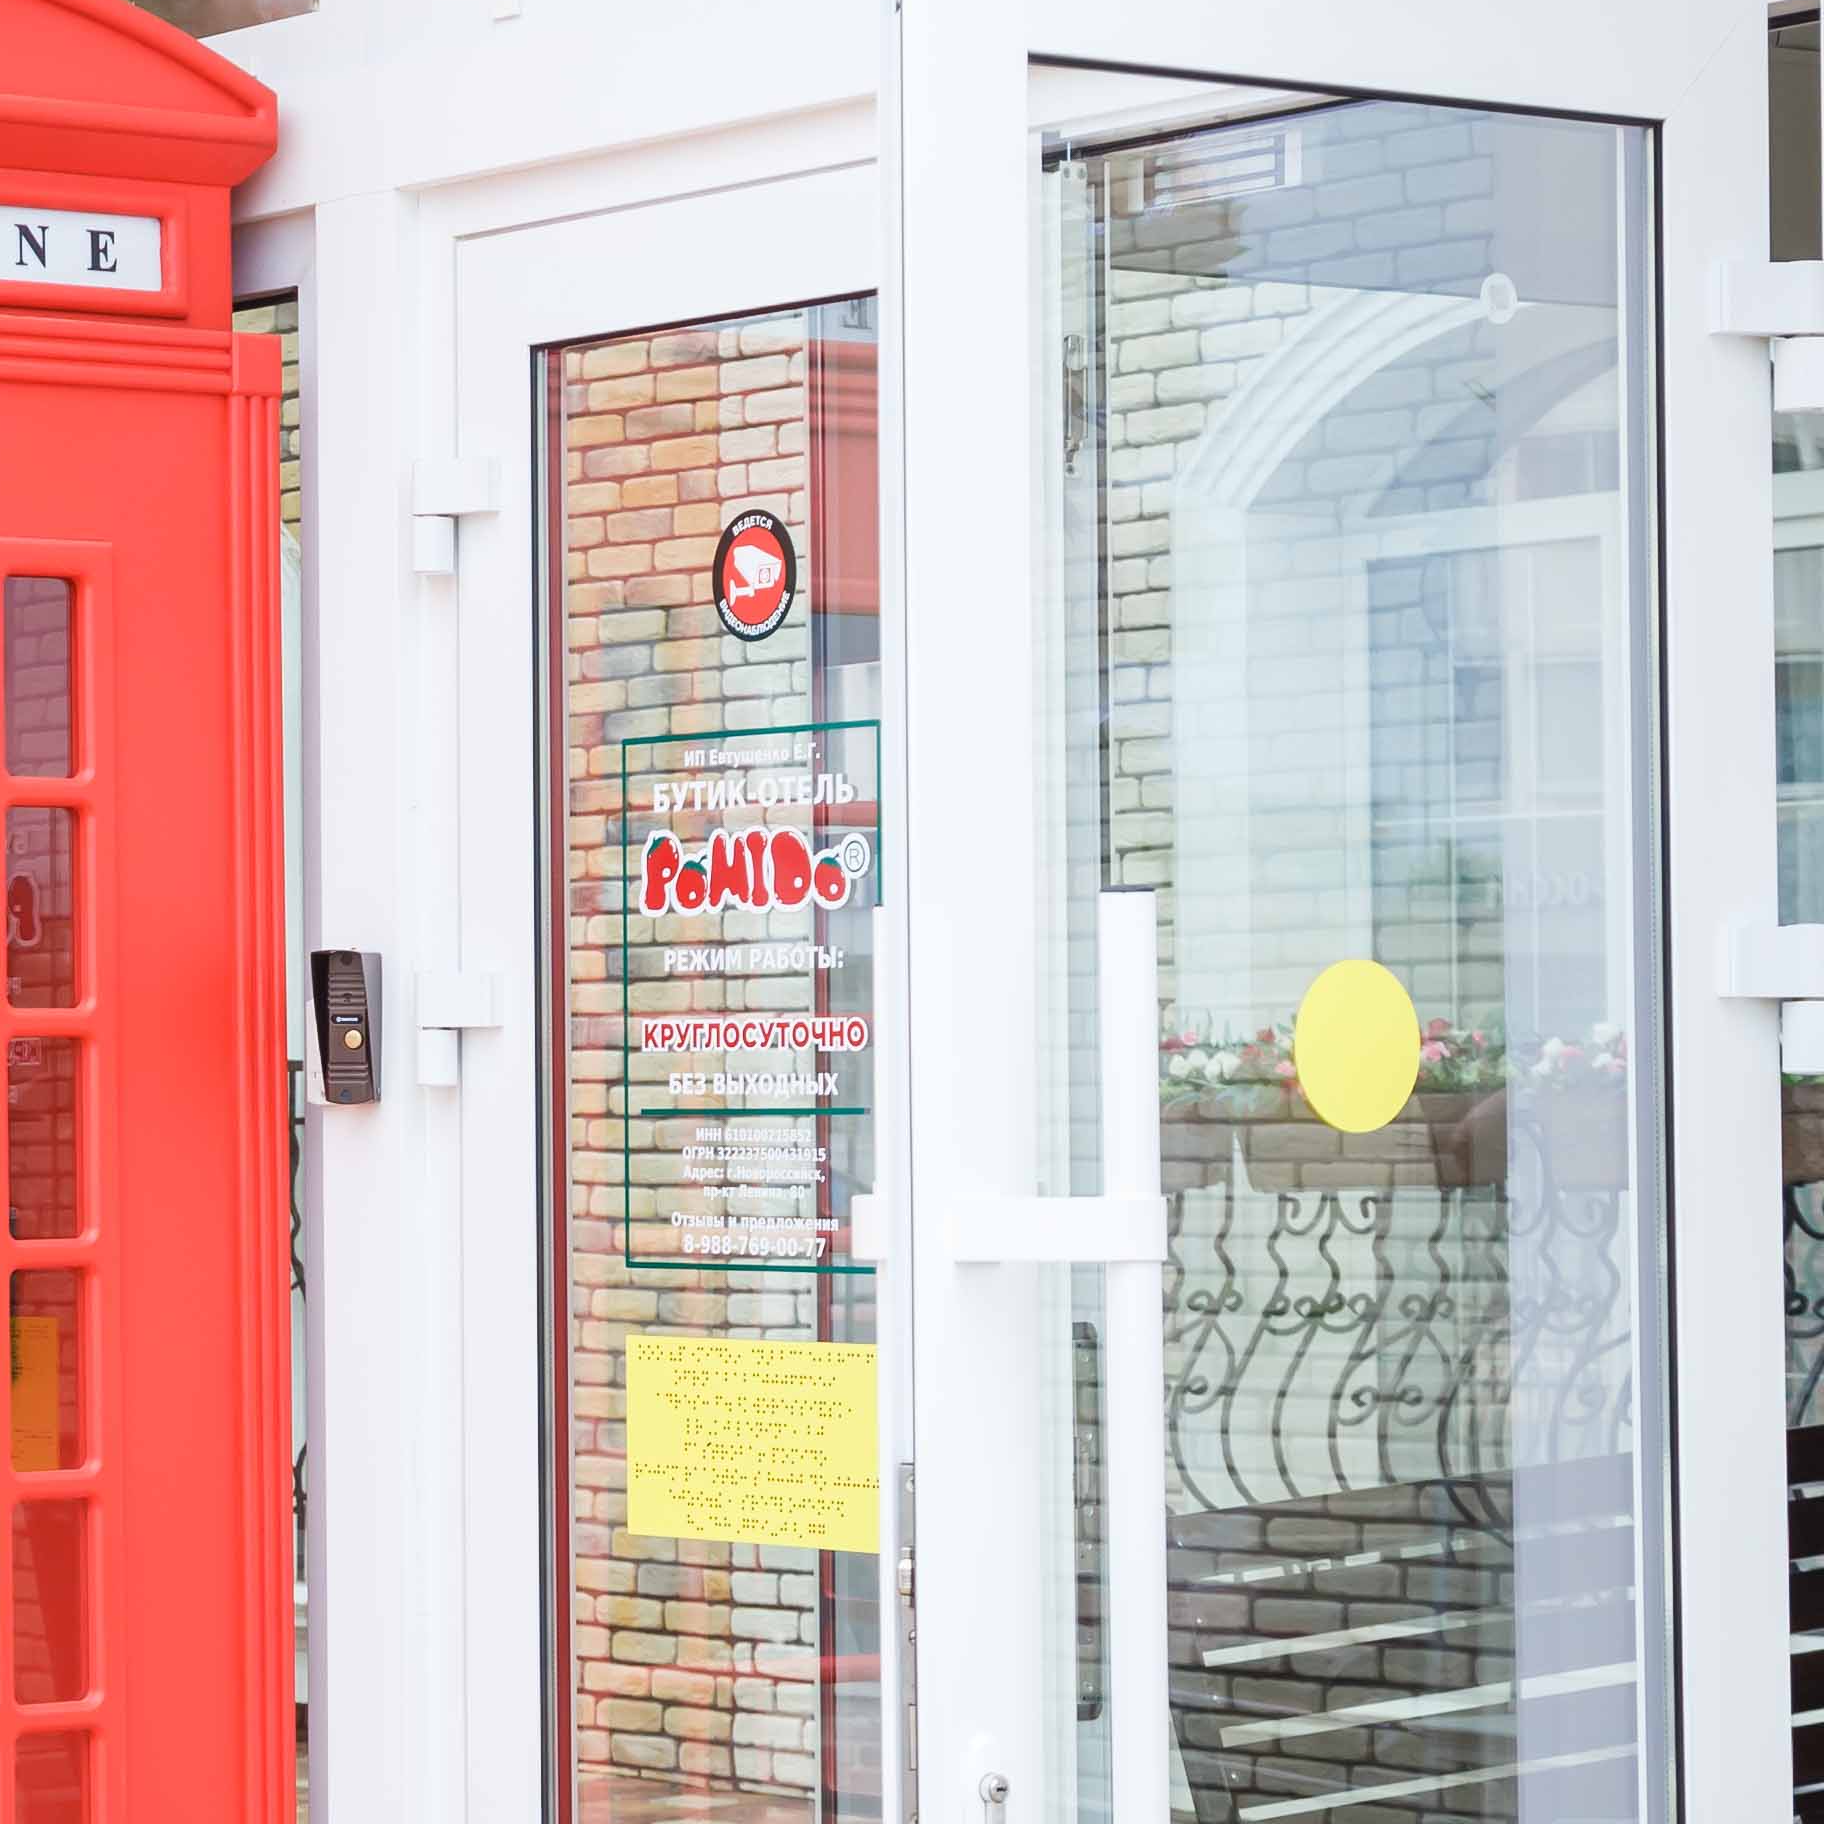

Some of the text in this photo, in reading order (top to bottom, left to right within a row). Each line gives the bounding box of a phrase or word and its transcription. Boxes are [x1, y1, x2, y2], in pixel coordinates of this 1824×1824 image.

[731, 515, 773, 537] ВЕДЕТСЯ
[719, 589, 791, 636] ВИДЕОНАБЛЮДЕНИЕ
[684, 749, 706, 768] ИП
[653, 773, 856, 813] БУТИК-ОТЕЛЬ
[663, 944, 845, 972] РЕЖИМ РАБОТЫ:
[642, 1019, 868, 1051] КРУГЛОСУТОЧНО
[668, 1072, 840, 1098] БЕЗ ВЫХОДНЫХ
[695, 1127, 722, 1142] ИНН
[682, 1146, 717, 1160] ОГРН
[671, 1211, 840, 1233] Отзывы и предложения
[682, 1233, 826, 1258] 8-988-769-00-77
